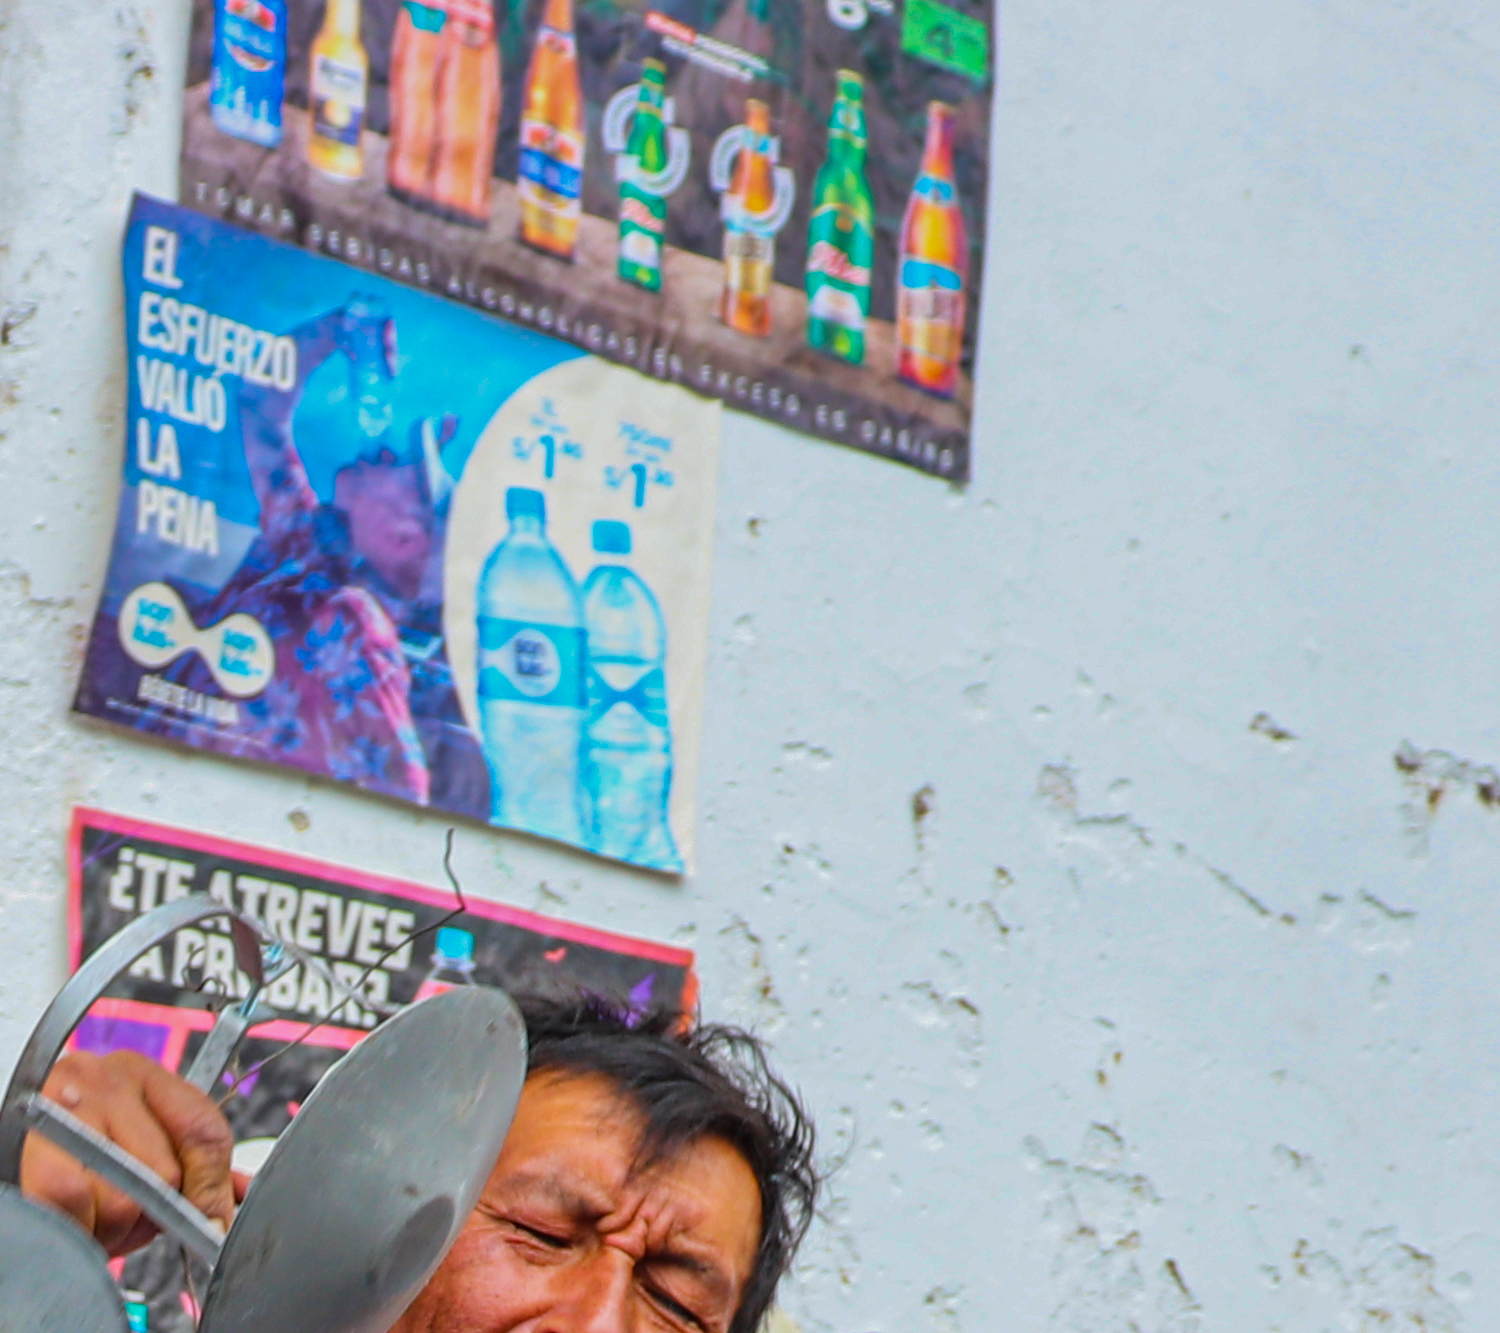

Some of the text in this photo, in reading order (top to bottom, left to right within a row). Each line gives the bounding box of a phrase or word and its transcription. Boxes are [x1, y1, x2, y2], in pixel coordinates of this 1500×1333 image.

[142, 225, 184, 290] EL
[138, 291, 298, 392] ESFUERZO
[195, 182, 294, 229] TOMAR
[309, 222, 430, 285] BEBIDAS
[654, 348, 683, 380] EN
[701, 364, 800, 416] EXCESO
[816, 404, 847, 433] ES
[136, 354, 227, 433] VALIÓ
[137, 416, 182, 480] LA
[137, 478, 219, 557] PENA
[109, 846, 415, 972] ¿TE ATREVES
[171, 927, 390, 1028] PRBAR?
